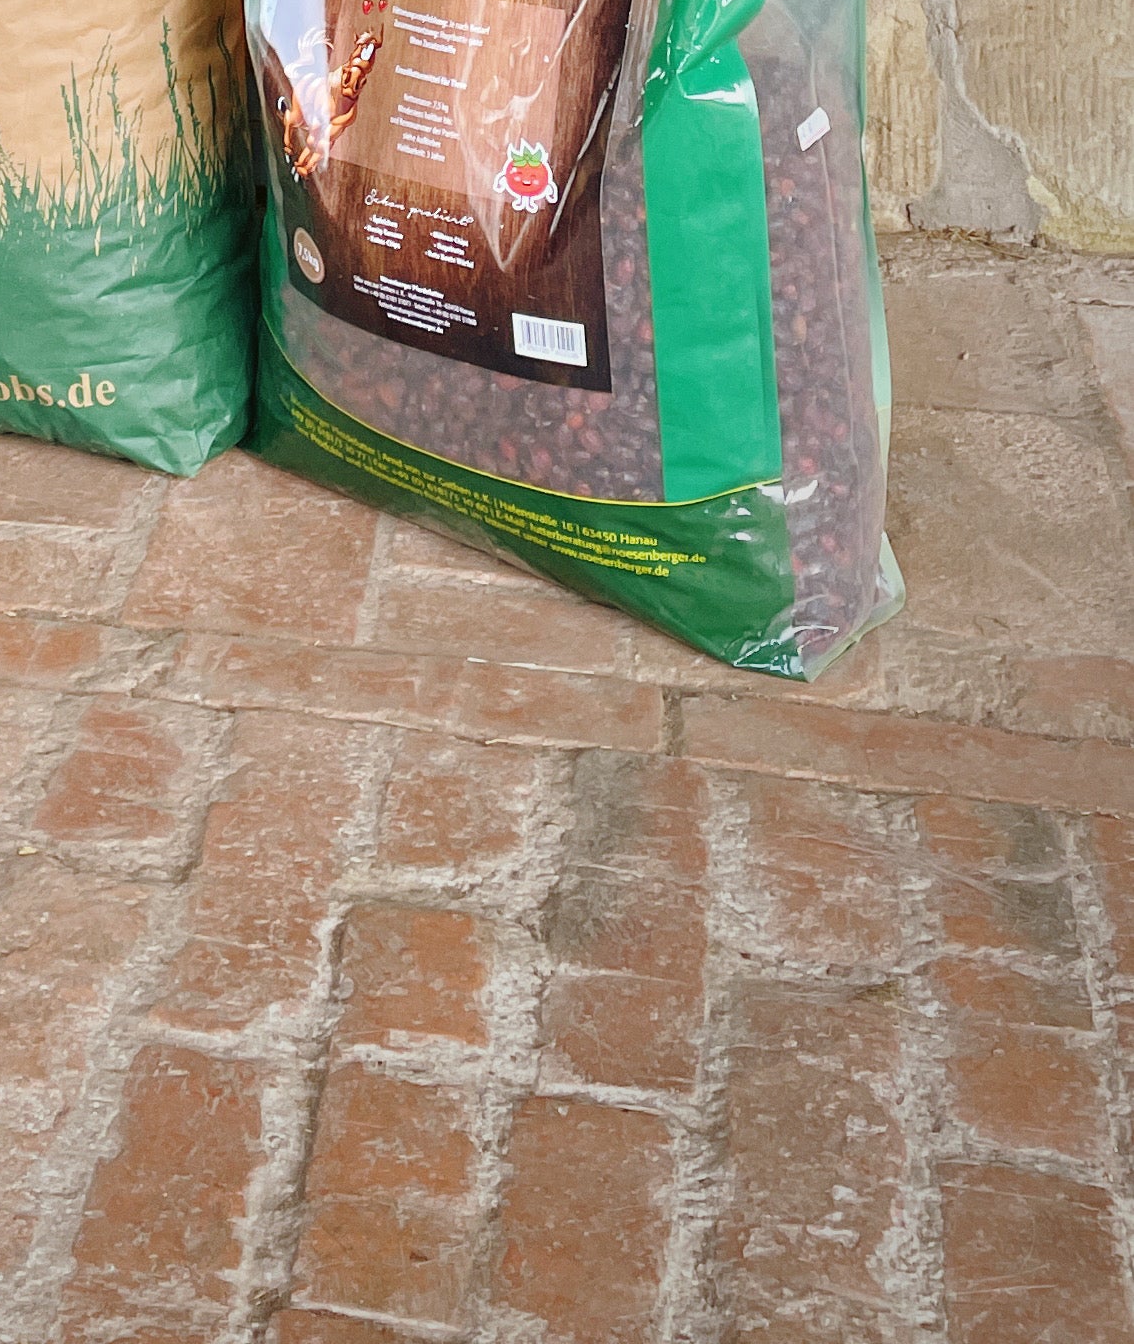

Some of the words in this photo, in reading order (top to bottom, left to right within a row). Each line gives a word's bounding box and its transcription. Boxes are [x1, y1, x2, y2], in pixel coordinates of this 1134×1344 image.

[365, 188, 405, 211] Schon
[581, 527, 618, 543] 63450
[619, 533, 659, 547] Hanau
[550, 542, 670, 577] www.noesenberger.de
